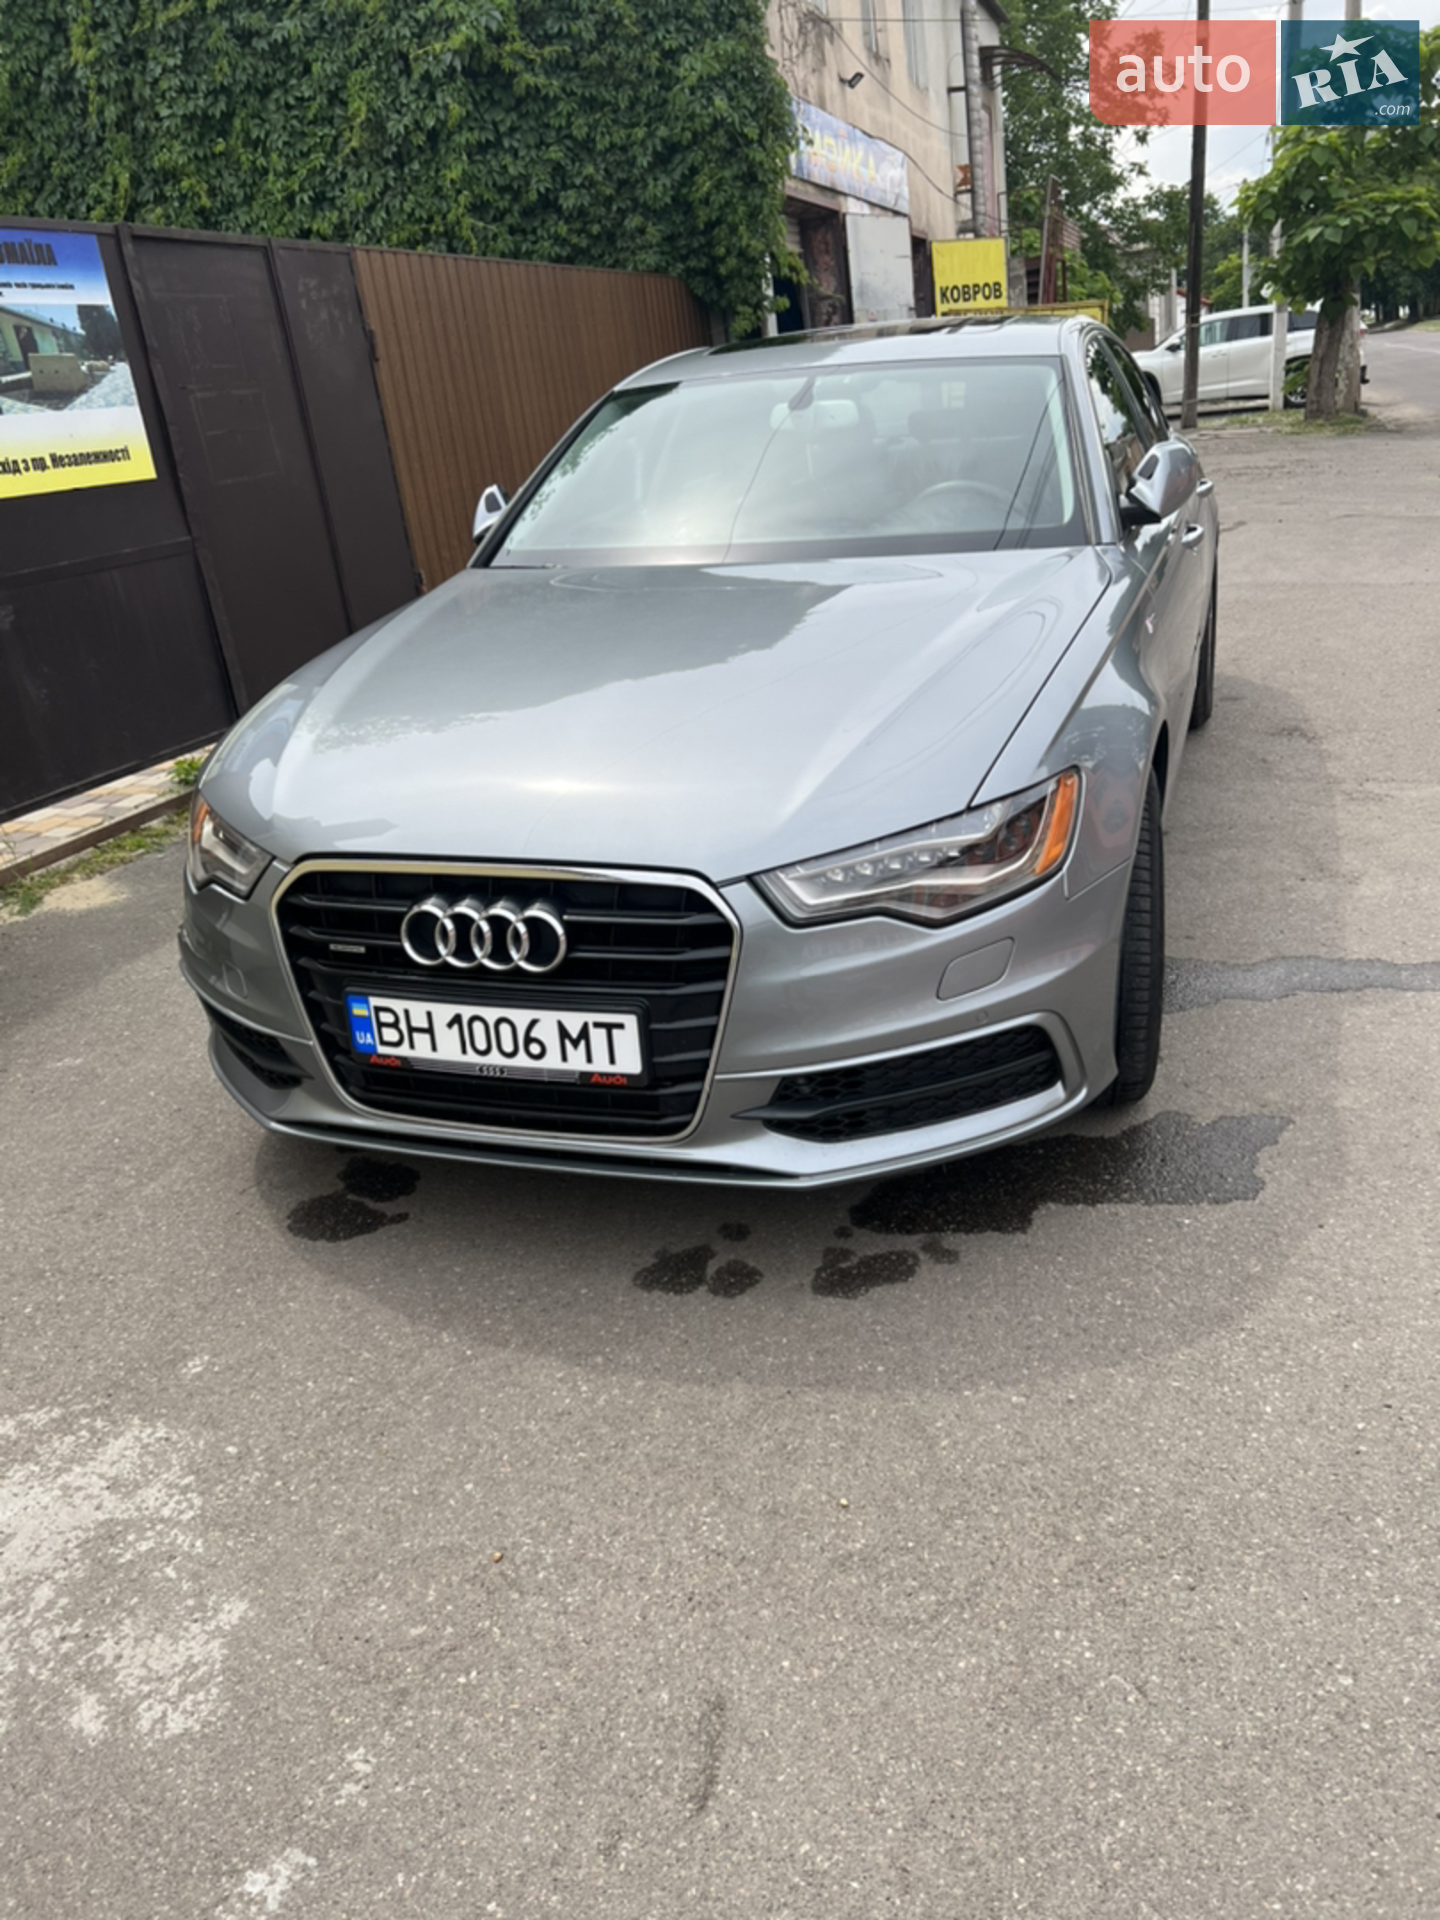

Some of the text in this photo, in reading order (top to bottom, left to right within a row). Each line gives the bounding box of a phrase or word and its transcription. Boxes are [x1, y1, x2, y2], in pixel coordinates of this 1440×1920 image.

[940, 281, 1003, 304] КОВРОВ
[0, 457, 22, 476] хід
[30, 456, 51, 472] пр.
[49, 444, 131, 469] Незалежності
[355, 1031, 374, 1046] UA
[373, 1005, 626, 1066] BH 1006 MT
